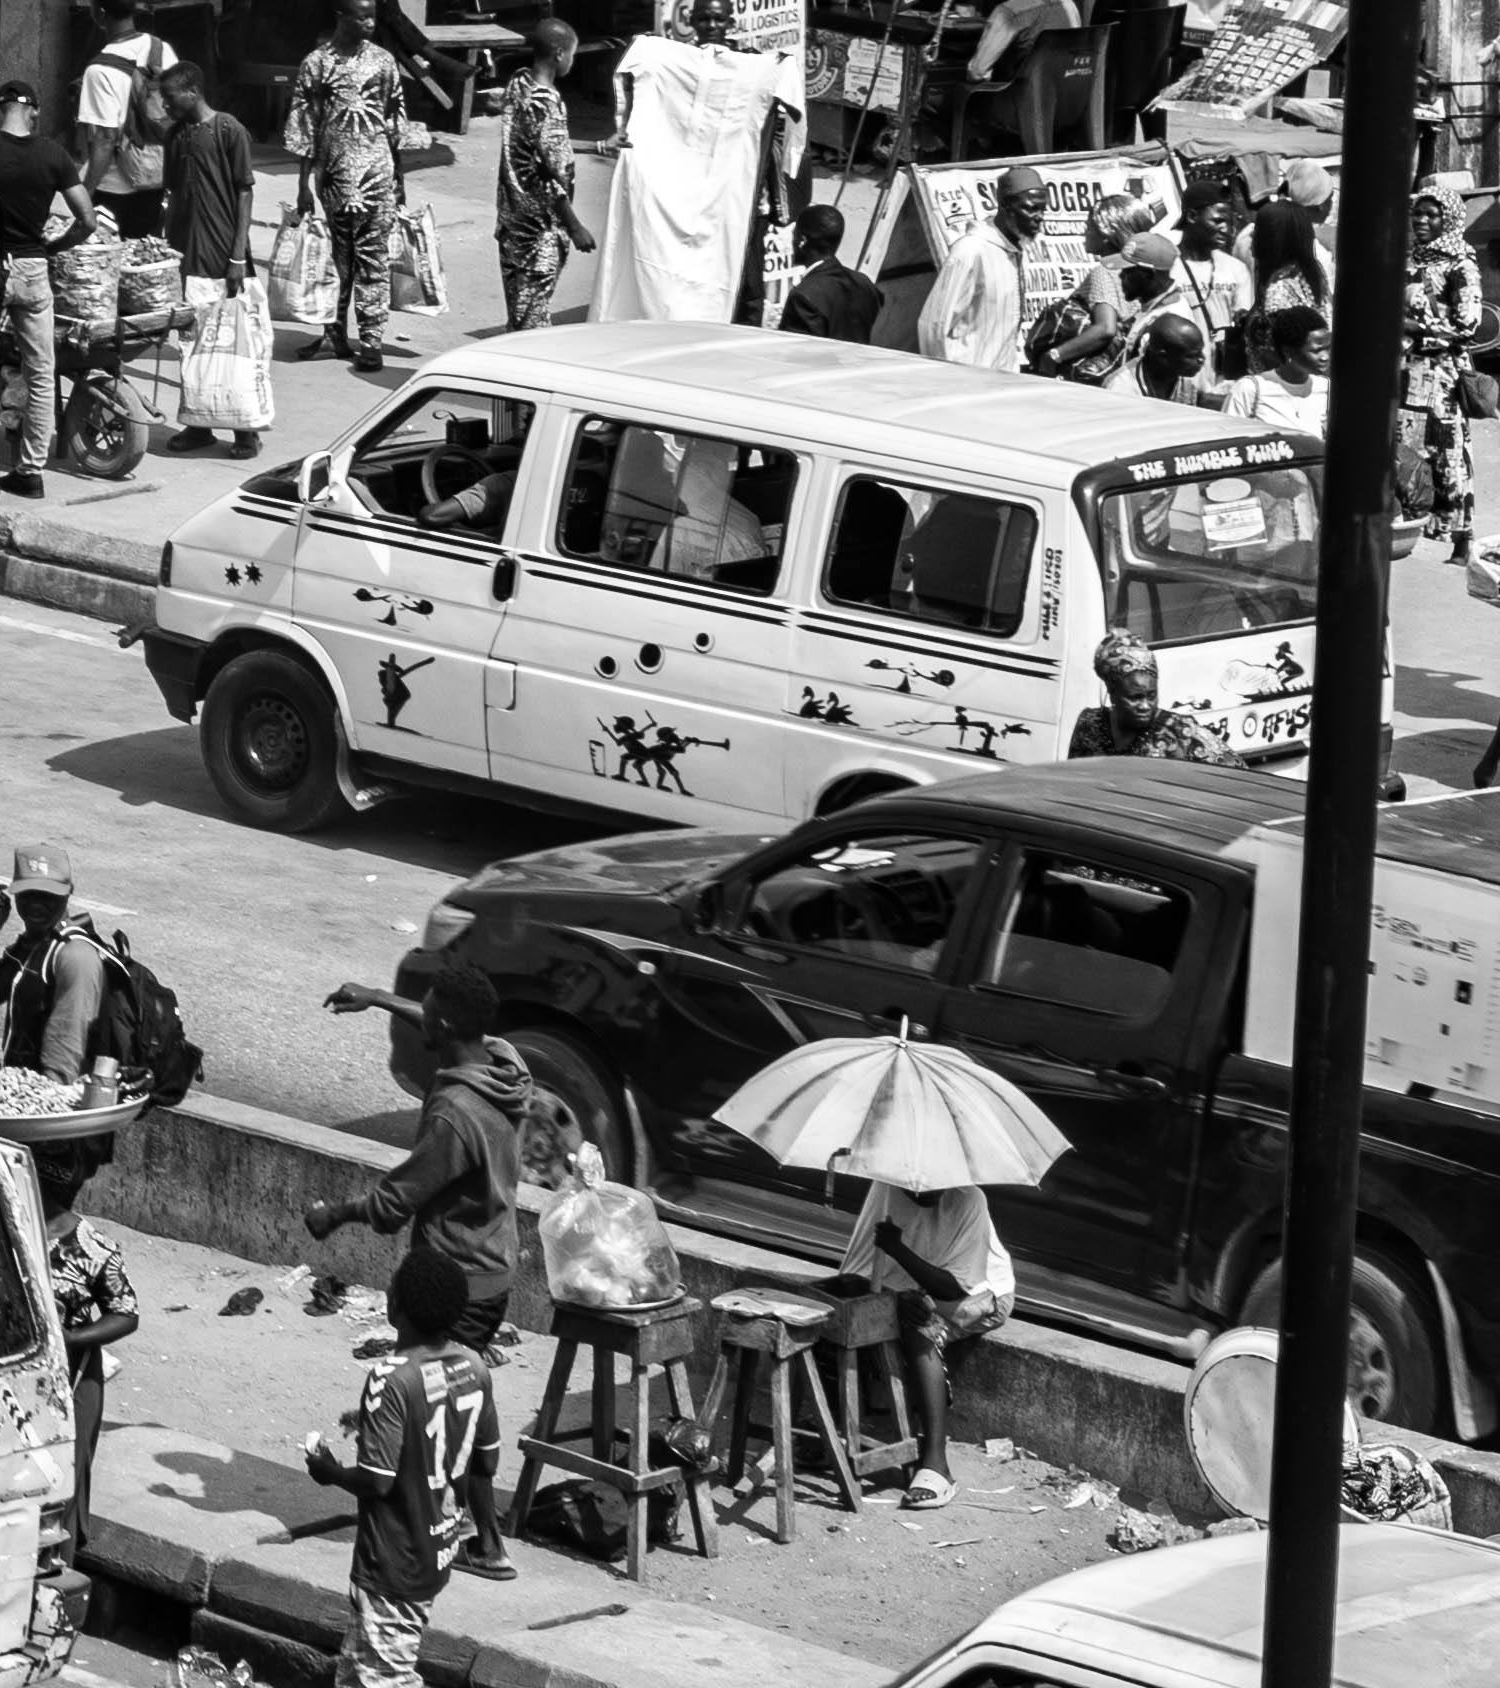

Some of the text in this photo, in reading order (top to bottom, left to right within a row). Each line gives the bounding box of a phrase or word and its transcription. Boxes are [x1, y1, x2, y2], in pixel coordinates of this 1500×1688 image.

[1128, 439, 1295, 482] THE HUMBLE KING
[425, 1388, 486, 1491] 17
